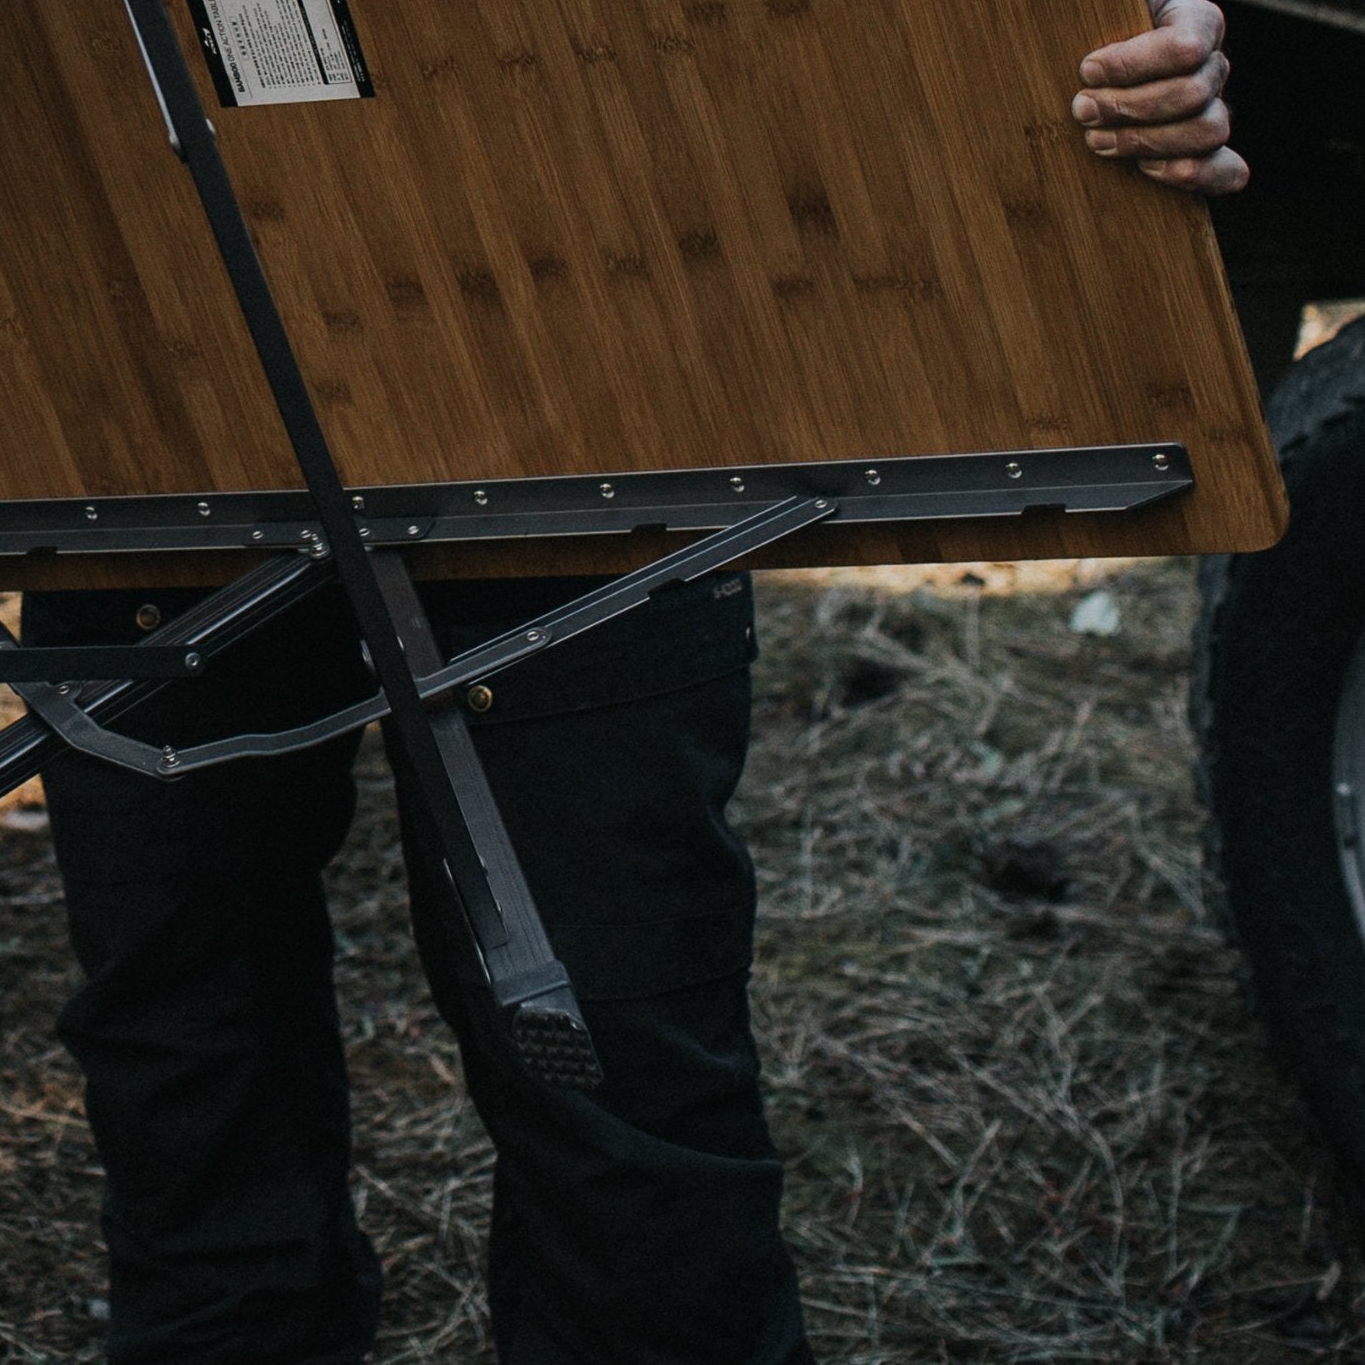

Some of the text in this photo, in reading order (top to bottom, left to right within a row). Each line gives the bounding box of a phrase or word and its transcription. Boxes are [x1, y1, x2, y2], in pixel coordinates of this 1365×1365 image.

[215, 20, 229, 45] ACTION
[223, 46, 234, 61] ONE
[227, 62, 245, 92] BAMBOO
